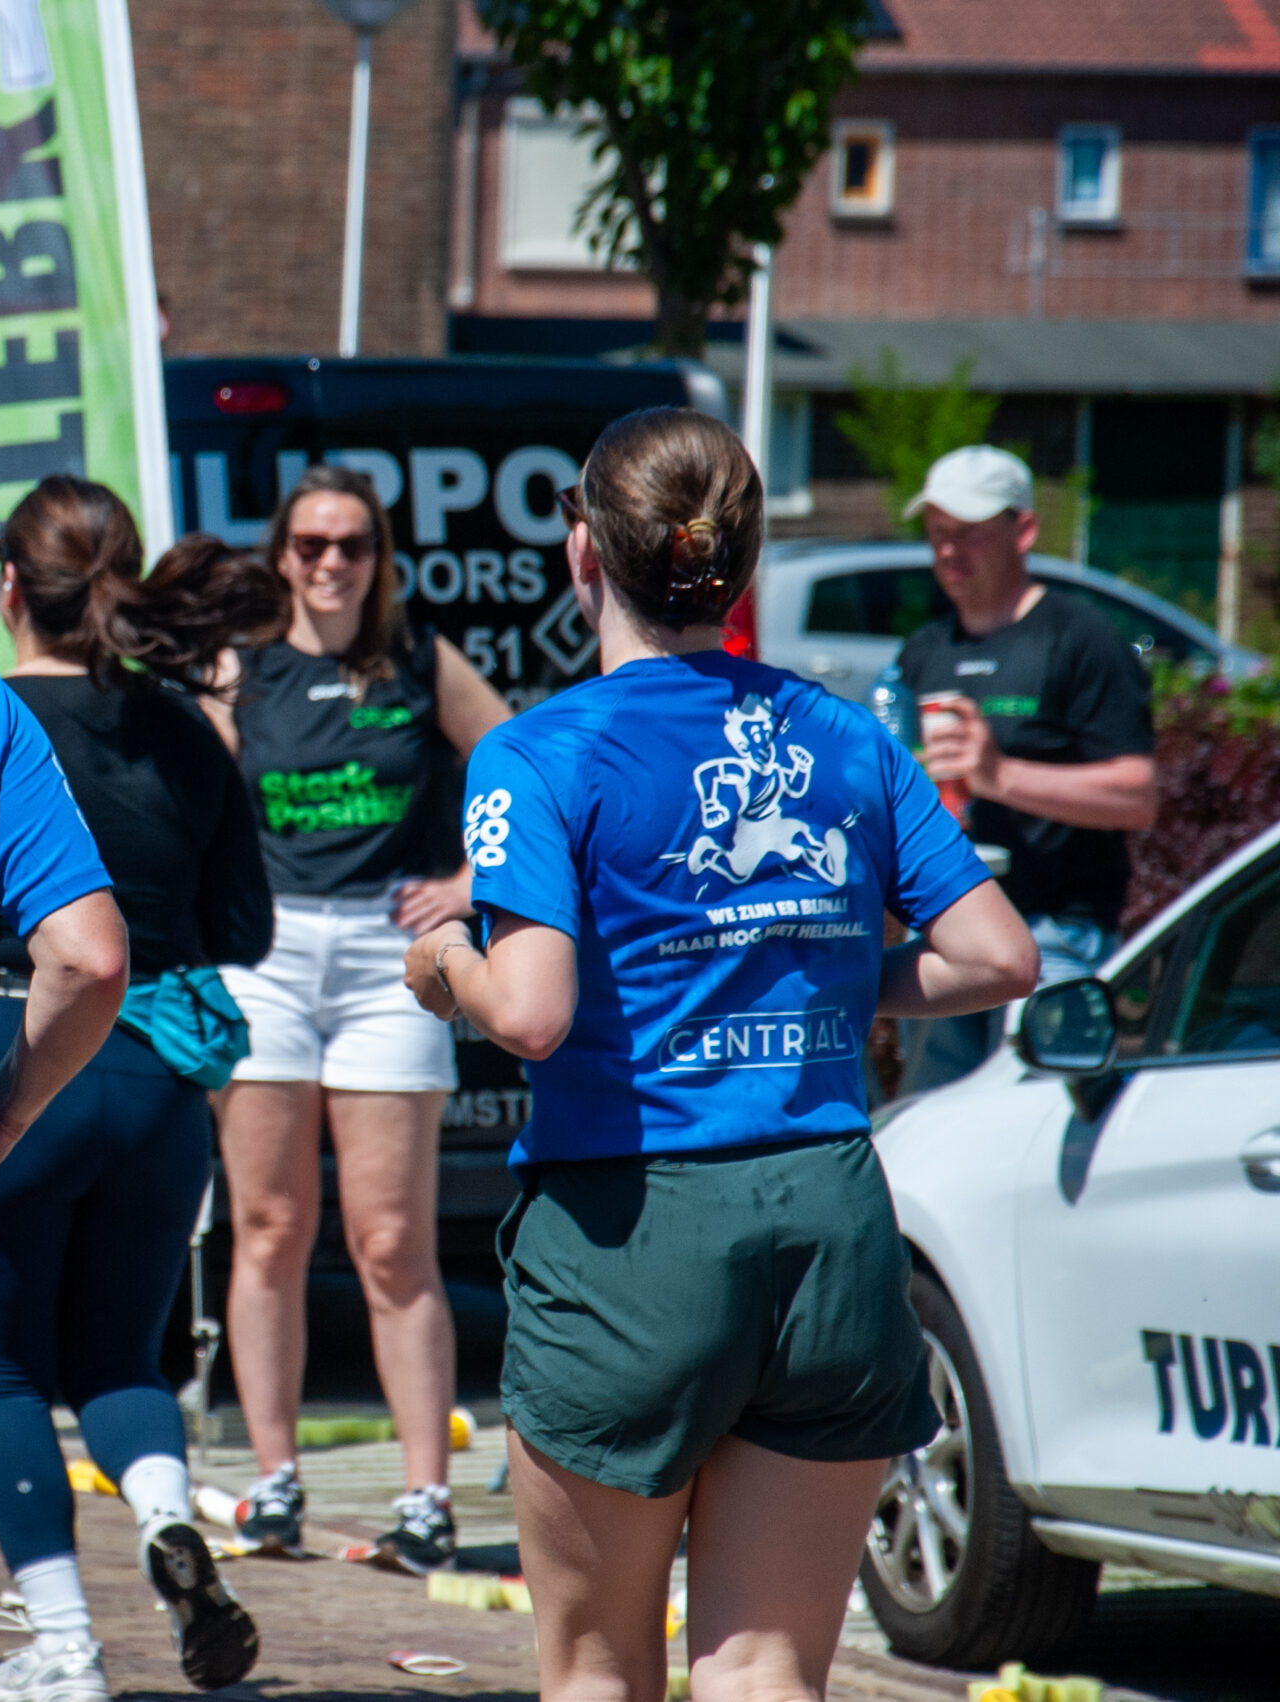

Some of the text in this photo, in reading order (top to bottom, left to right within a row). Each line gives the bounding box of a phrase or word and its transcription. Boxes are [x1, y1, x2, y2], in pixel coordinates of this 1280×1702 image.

[464, 624, 523, 679] 51
[465, 787, 512, 825] GO
[464, 817, 510, 849] GO
[706, 898, 849, 926] WE ZIJN ER BIJNA!
[659, 934, 715, 956] MAAR
[719, 927, 763, 948] NOG
[763, 924, 798, 938] NIET
[668, 1007, 848, 1062] CENTRAL+
[1140, 1327, 1280, 1449] TUR
